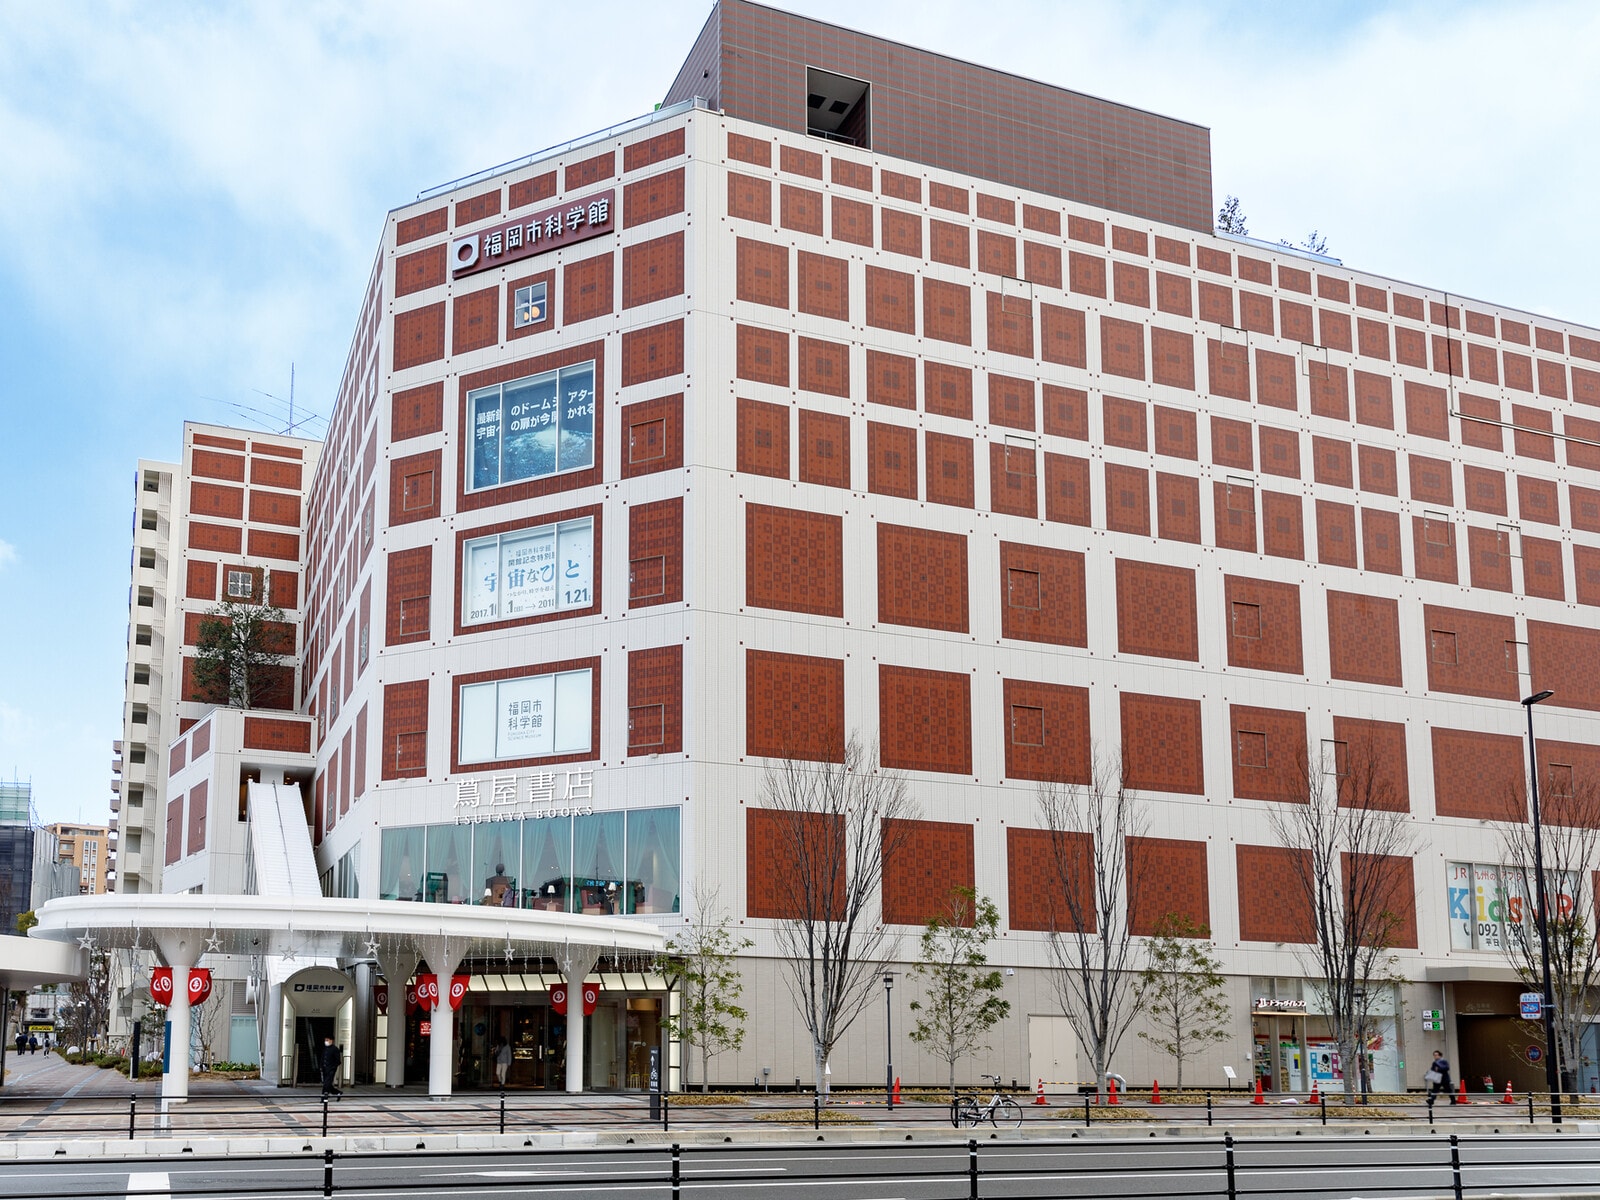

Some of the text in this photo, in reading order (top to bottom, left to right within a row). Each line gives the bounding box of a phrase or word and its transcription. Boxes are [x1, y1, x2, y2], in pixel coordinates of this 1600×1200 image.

[483, 198, 609, 257] 福岡市科学館
[508, 699, 542, 716] 福岡市
[508, 714, 543, 731] 科学館
[453, 767, 594, 809] 蔦屋書店
[454, 806, 594, 825] TSUTAYA BOOKS
[1449, 886, 1522, 923] Kids
